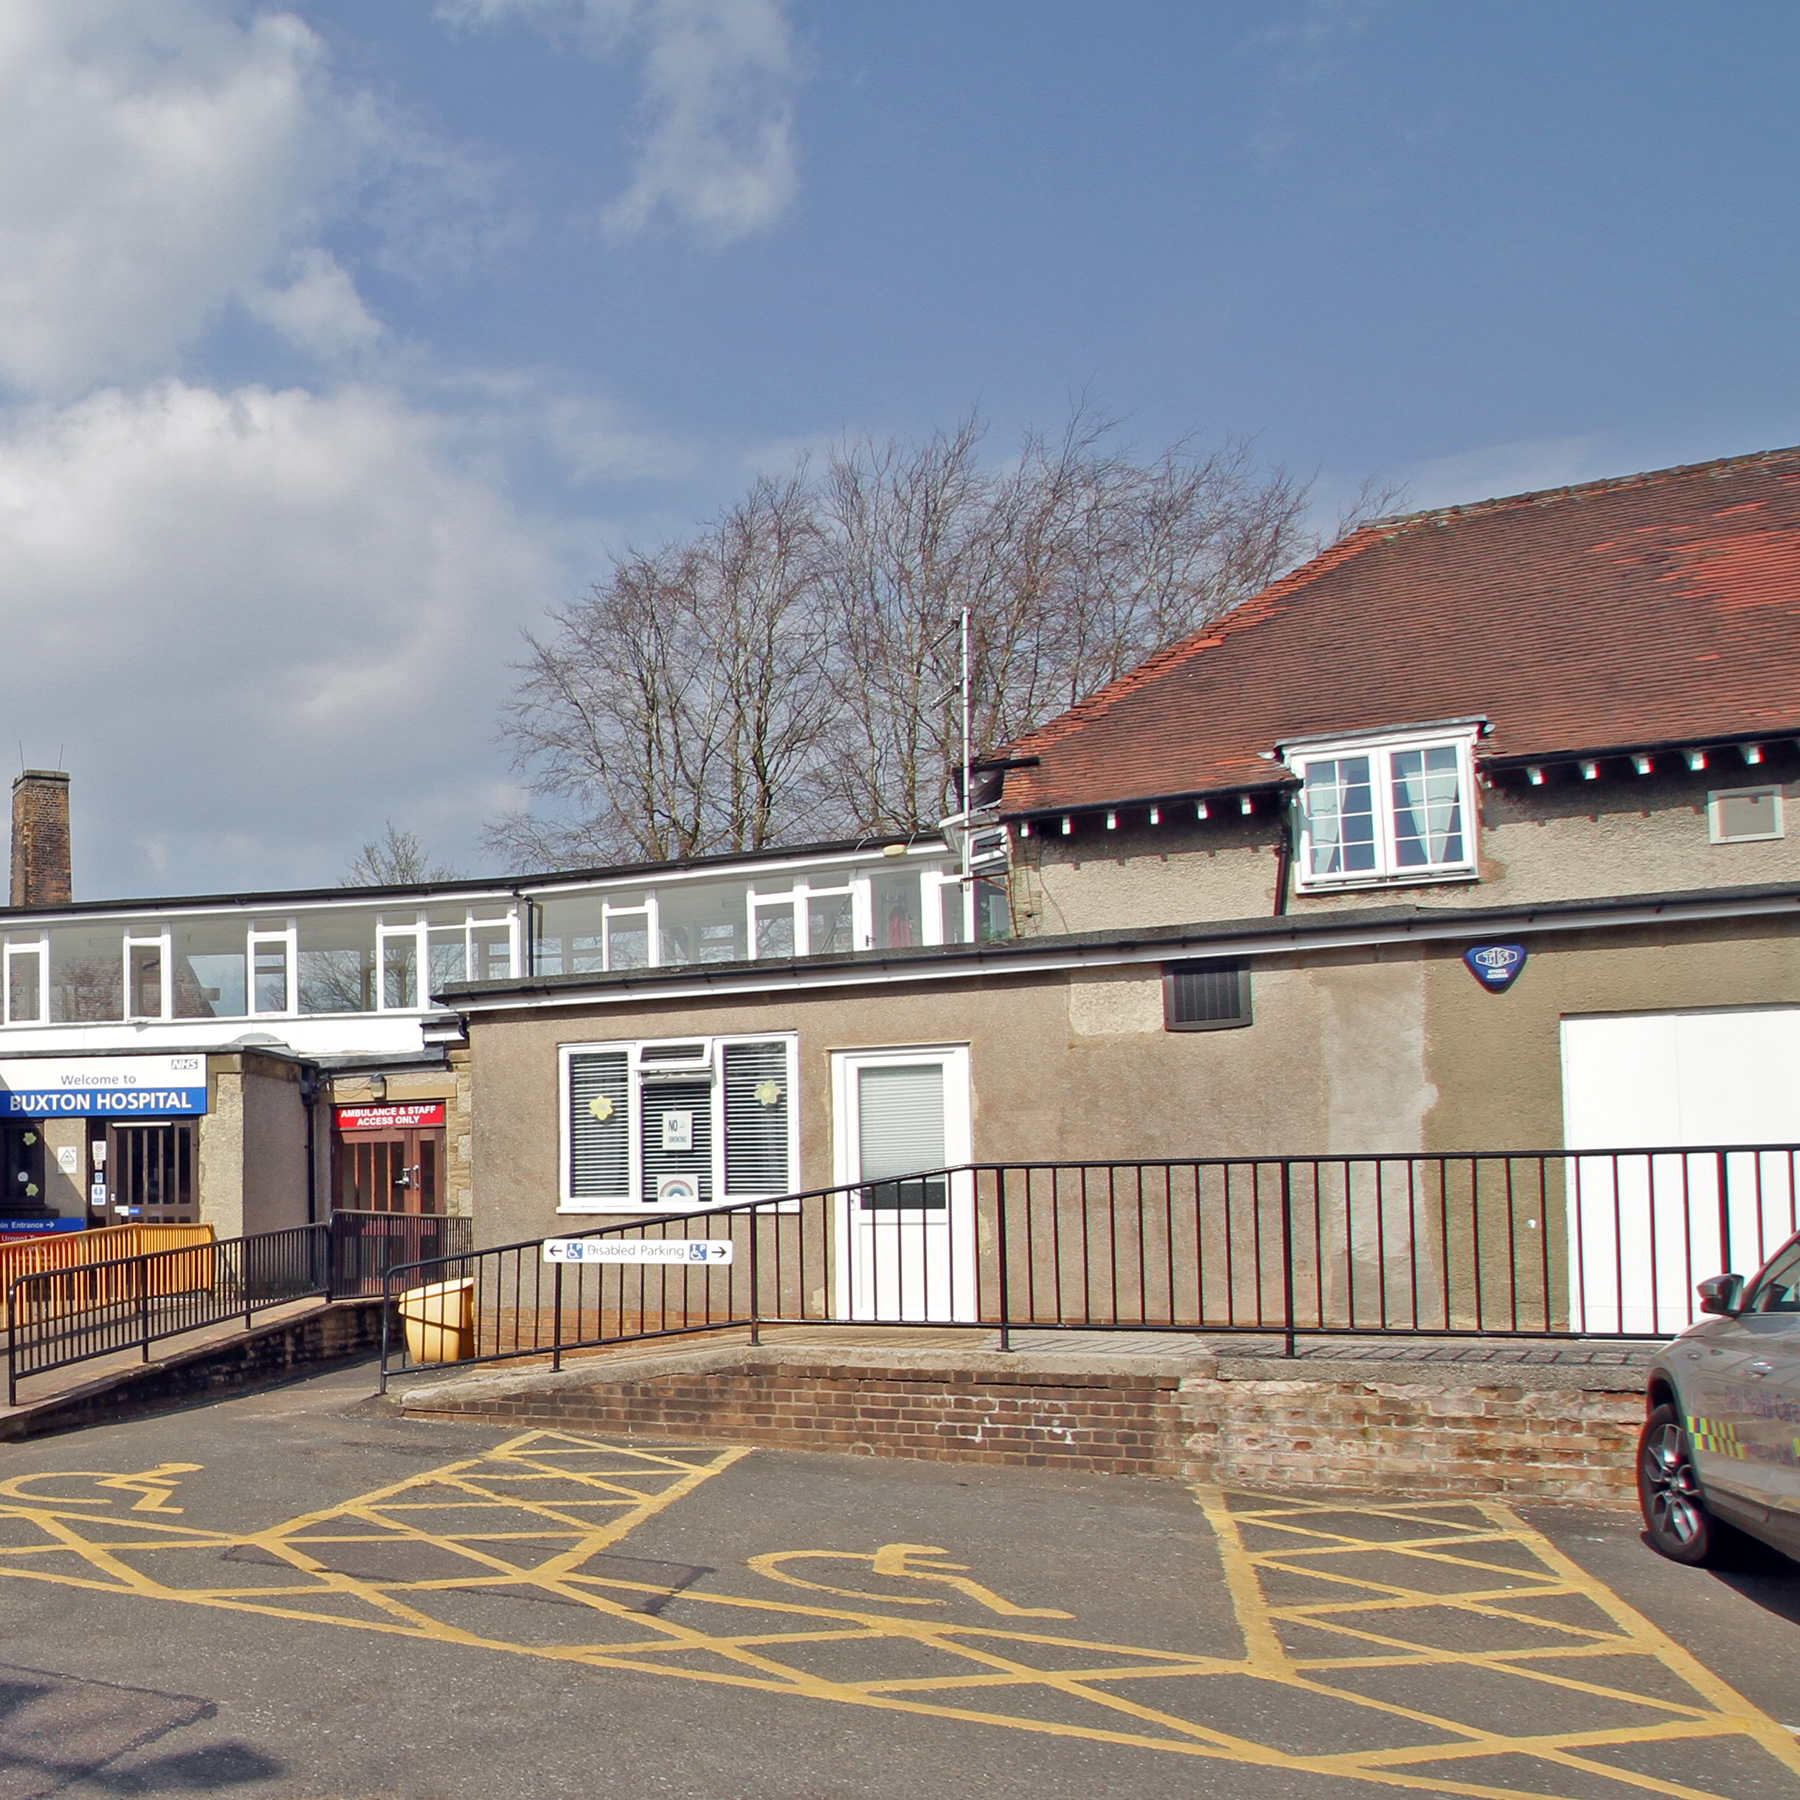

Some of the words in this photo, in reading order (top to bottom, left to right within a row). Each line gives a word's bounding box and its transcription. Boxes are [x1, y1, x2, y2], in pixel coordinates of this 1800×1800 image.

[171, 1059, 198, 1070] NHS
[61, 1075, 119, 1086] Welcome
[123, 1074, 137, 1085] to
[10, 1093, 90, 1111] BUXTON
[96, 1091, 192, 1110] HOSPITAL
[341, 1107, 397, 1118] AMBULANCE
[399, 1106, 406, 1115] &
[408, 1105, 436, 1115] STAFF
[357, 1117, 393, 1126] ACCESS
[395, 1115, 420, 1124] ONLY
[668, 1119, 678, 1132] NO
[11, 1221, 44, 1229] Entrance
[587, 1244, 635, 1256] Disabled
[640, 1245, 685, 1259] Parking
